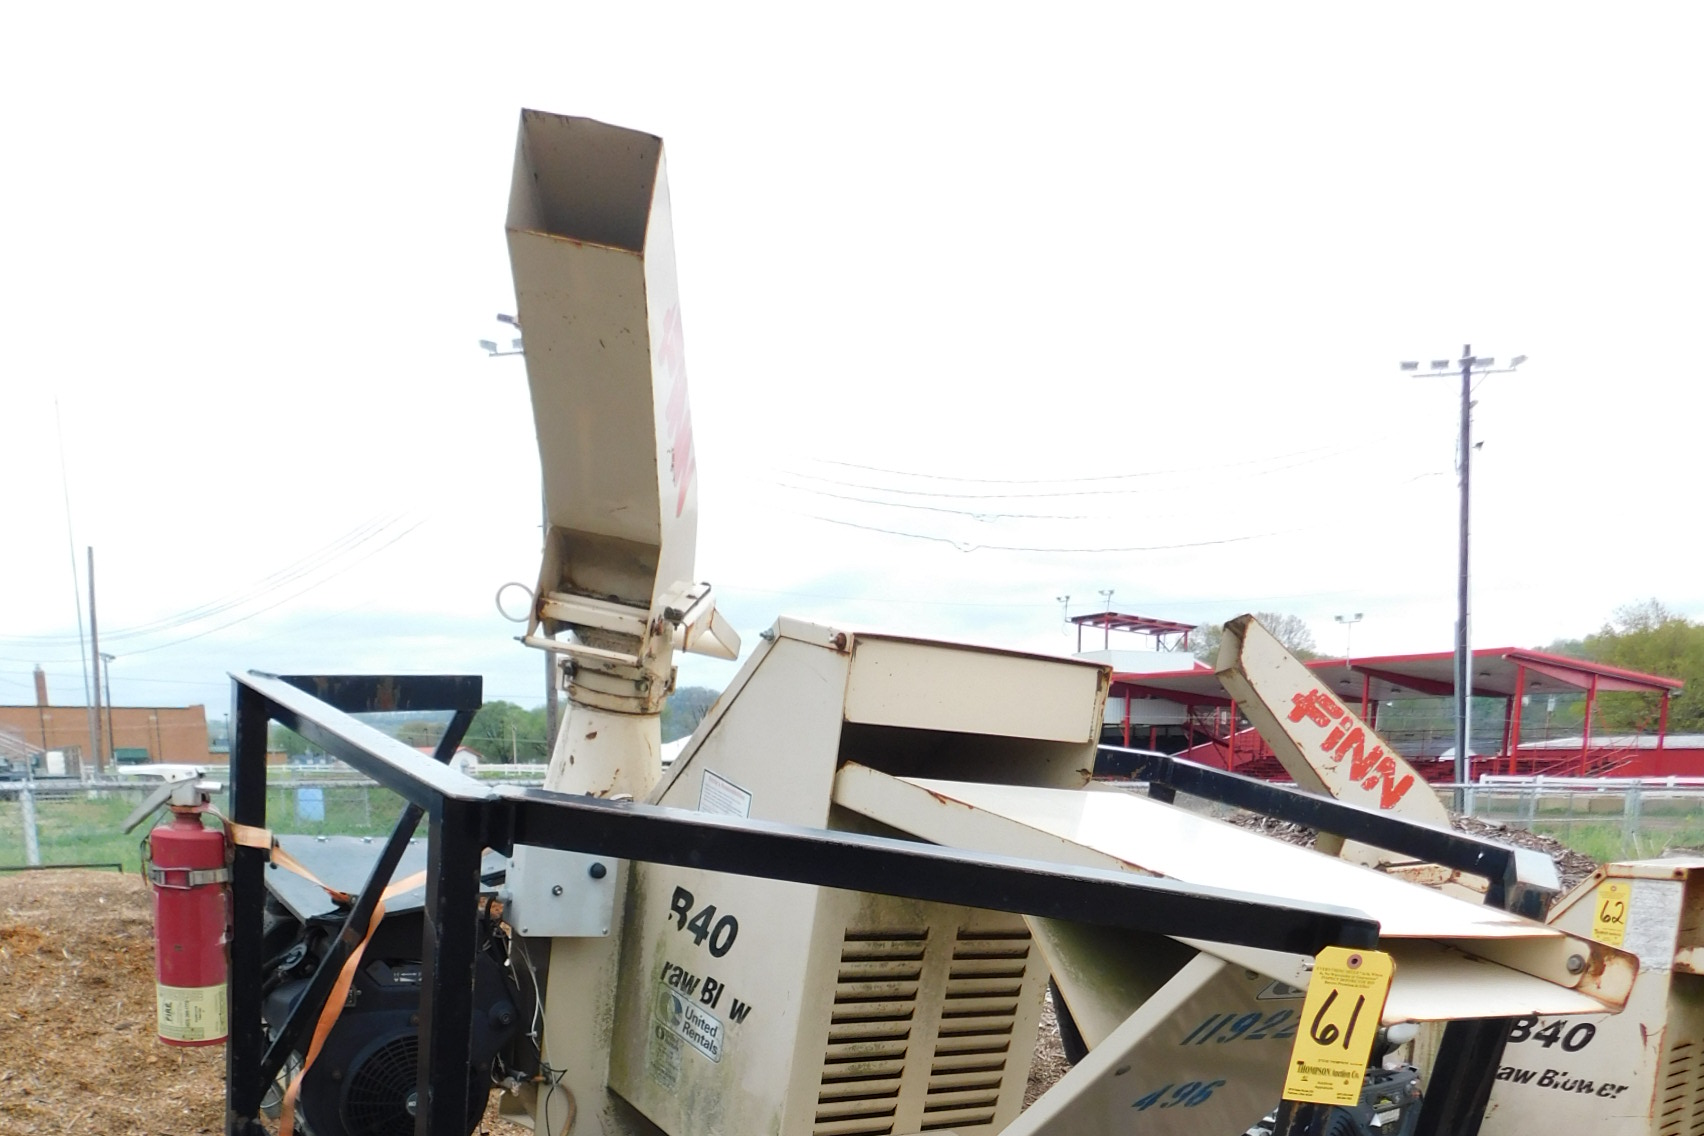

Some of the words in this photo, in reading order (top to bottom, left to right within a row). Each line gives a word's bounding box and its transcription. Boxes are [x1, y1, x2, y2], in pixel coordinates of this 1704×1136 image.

[1600, 900, 1624, 925] 62
[684, 1005, 719, 1039] United
[1310, 988, 1366, 1051] 61
[682, 1021, 719, 1056] Rentals
[1297, 1063, 1331, 1077] THOMPSON
[1496, 1065, 1538, 1085] aw
